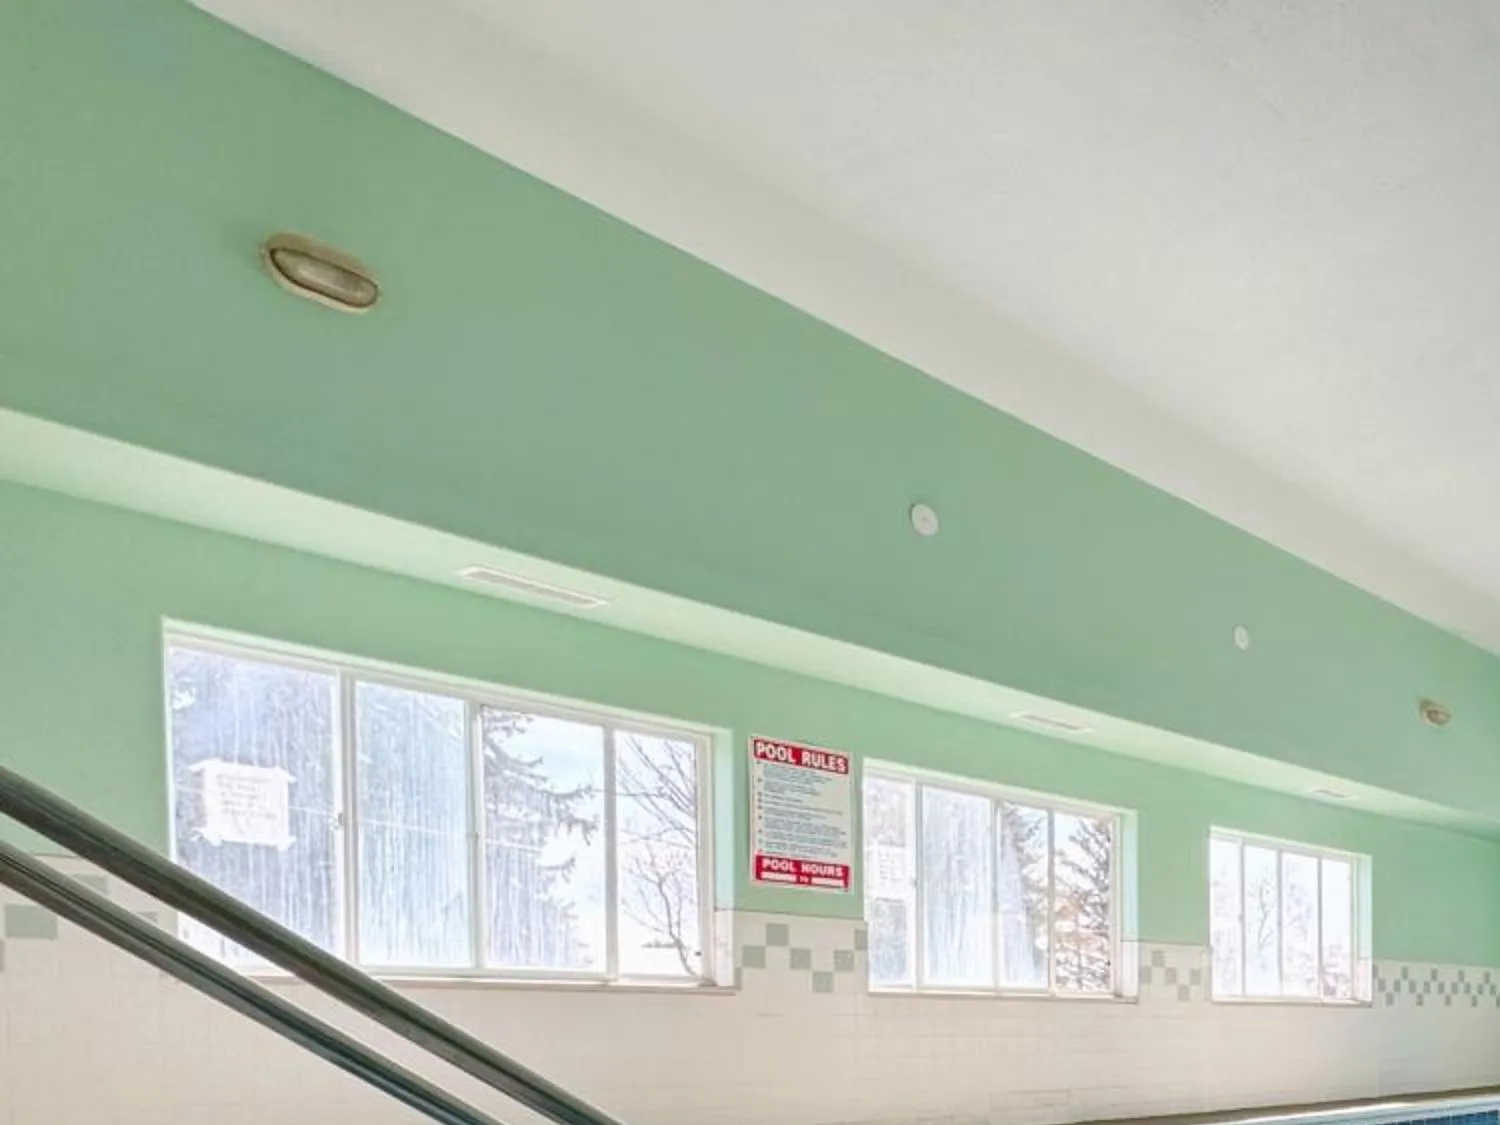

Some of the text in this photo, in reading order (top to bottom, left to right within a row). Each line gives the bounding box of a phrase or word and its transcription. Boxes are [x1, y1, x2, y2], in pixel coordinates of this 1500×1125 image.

[756, 741, 846, 773] POOL RULES
[762, 858, 844, 877] POOL HOURS
